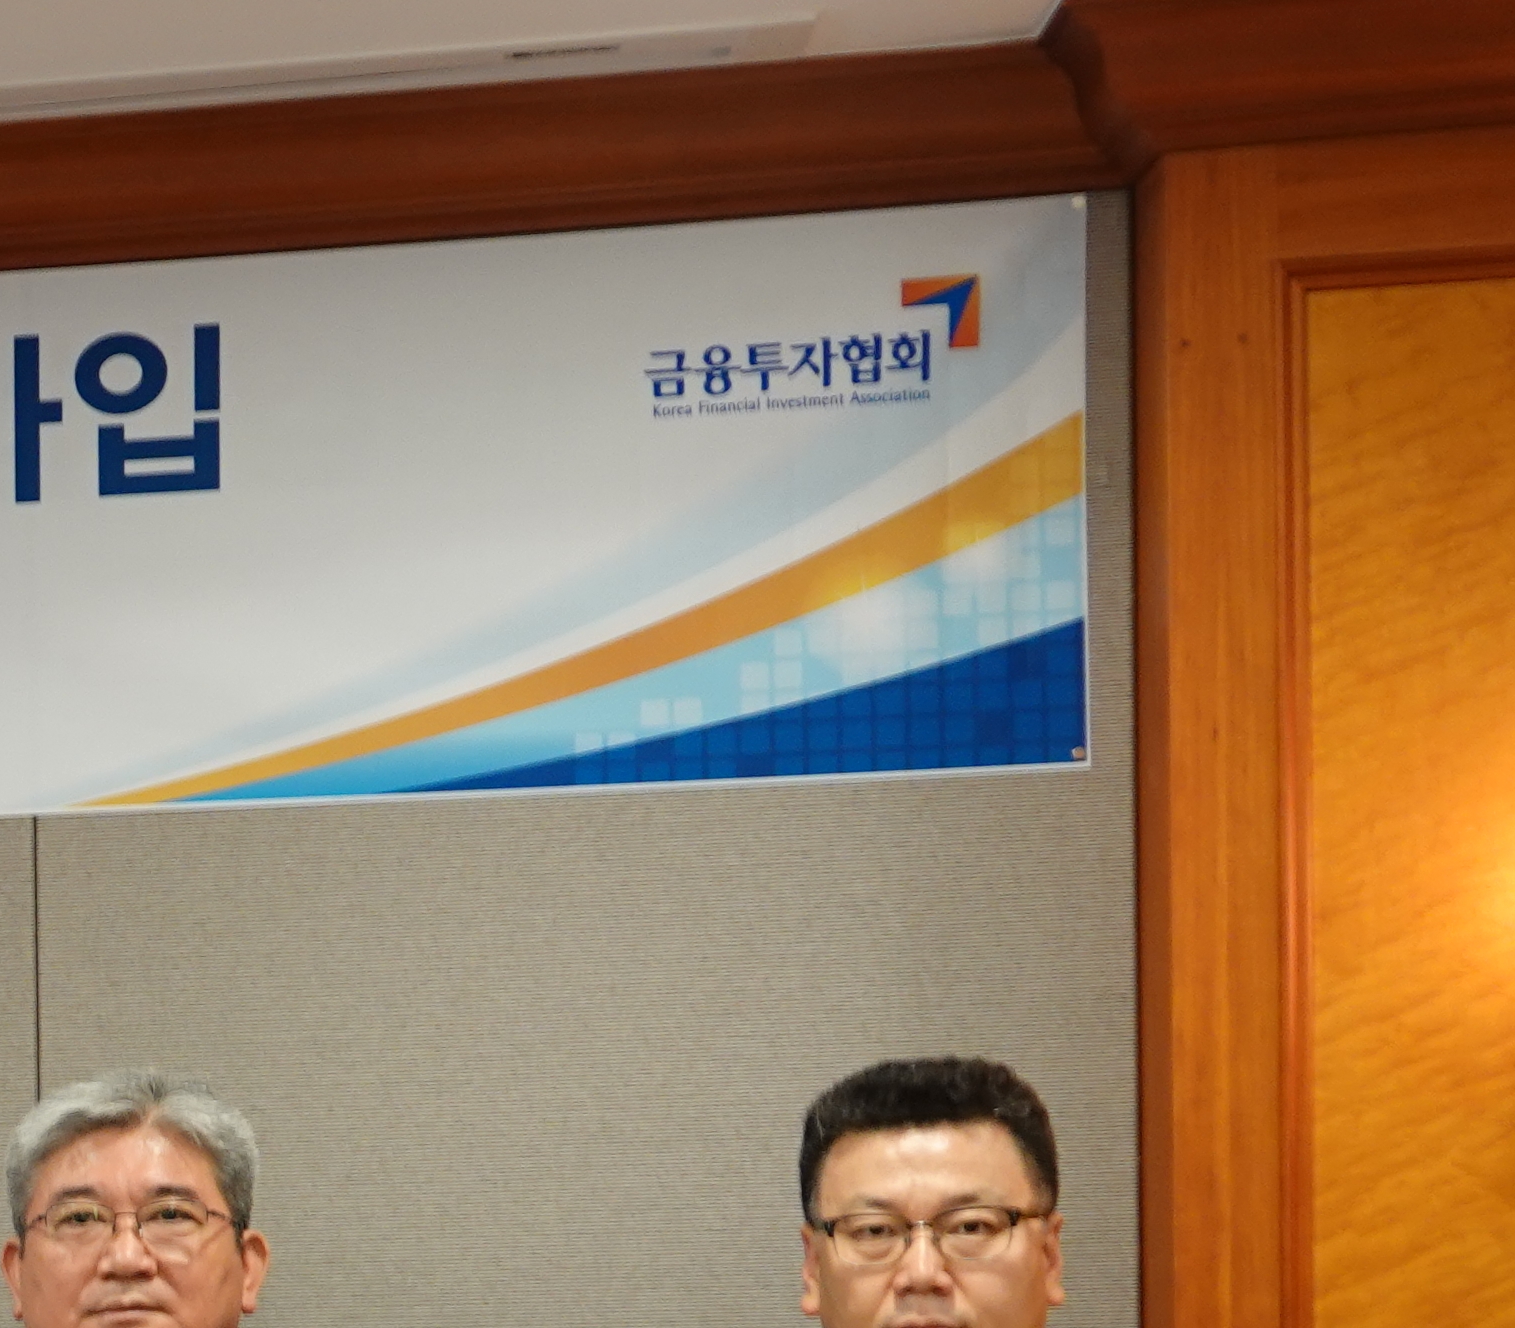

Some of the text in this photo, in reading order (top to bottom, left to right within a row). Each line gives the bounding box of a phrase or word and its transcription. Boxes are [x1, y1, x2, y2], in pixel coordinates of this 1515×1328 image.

[643, 329, 931, 397] 금융투자협회
[652, 387, 932, 418] Korea Financial Investment Association
